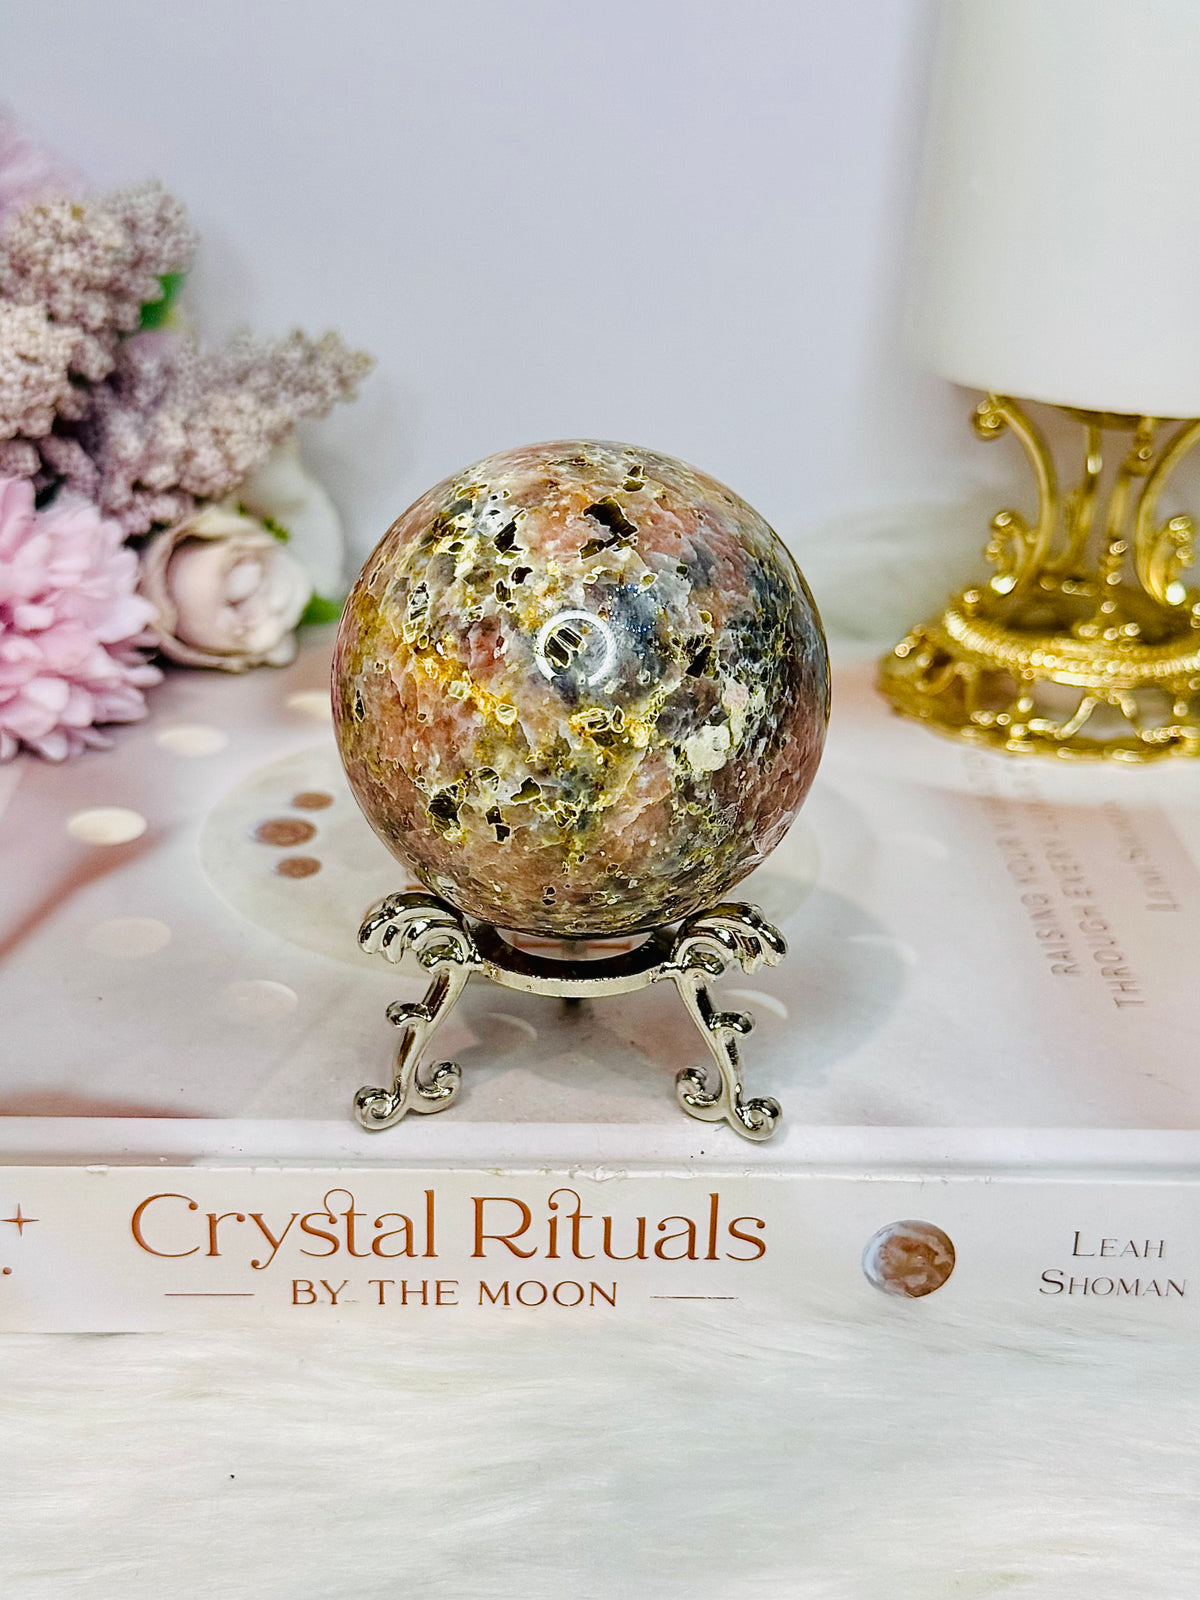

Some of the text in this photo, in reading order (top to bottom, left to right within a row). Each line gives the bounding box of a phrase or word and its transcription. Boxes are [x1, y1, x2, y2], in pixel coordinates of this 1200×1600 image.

[1020, 893, 1081, 976] RAISING
[1070, 904, 1147, 1008] THROUGH
[131, 1188, 766, 1270] Crystal Rituals
[1072, 1231, 1165, 1259] LEAH
[291, 1279, 617, 1308] BY THE MOON
[1039, 1269, 1187, 1299] SHOMAN
